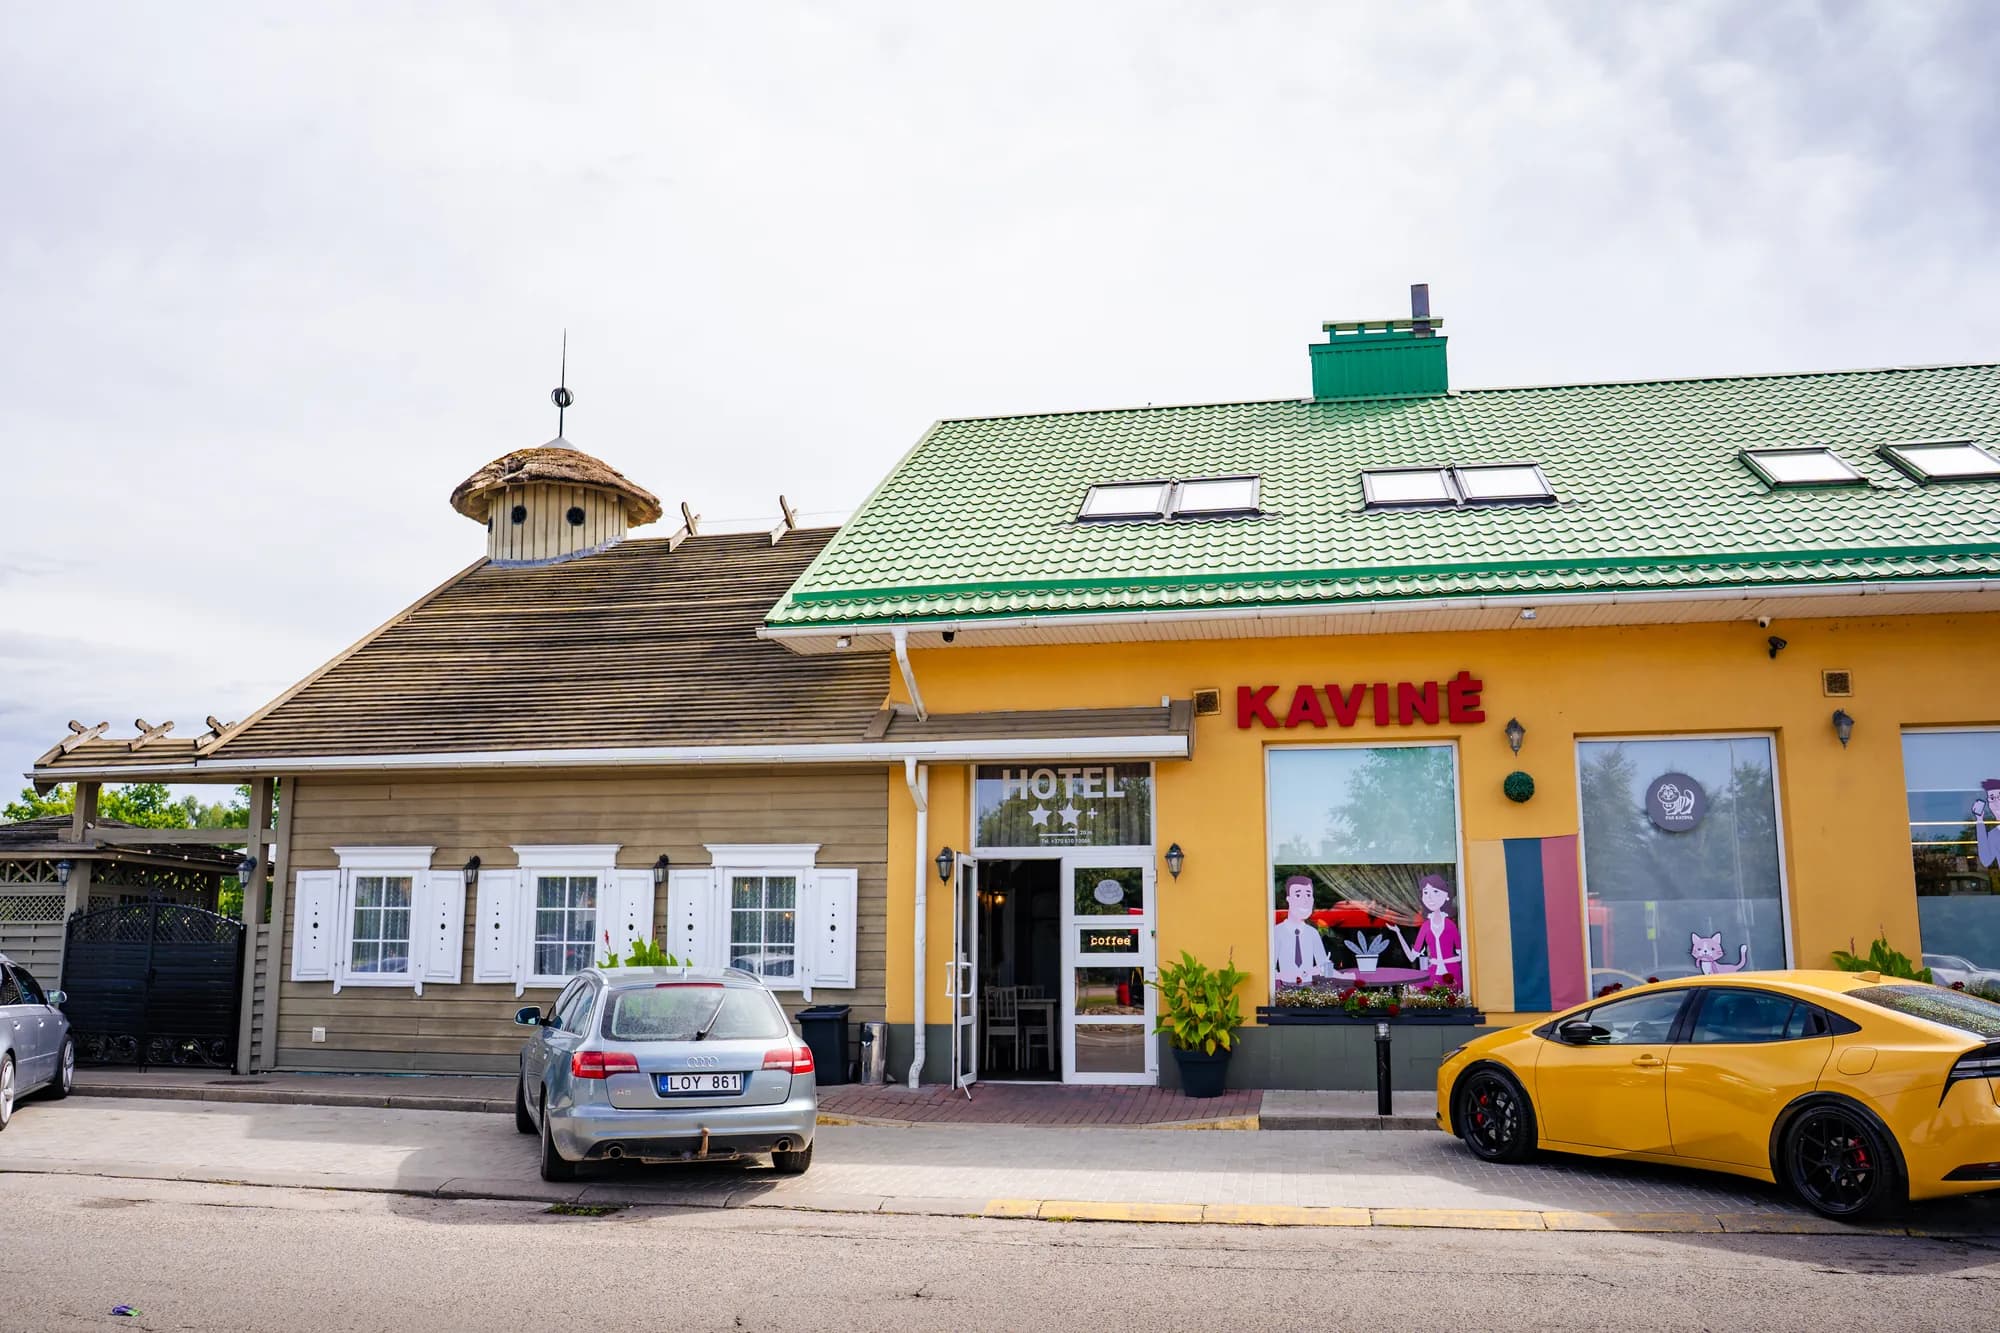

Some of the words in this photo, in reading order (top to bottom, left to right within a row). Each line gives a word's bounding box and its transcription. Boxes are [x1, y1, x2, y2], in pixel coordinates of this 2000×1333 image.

[1237, 671, 1486, 729] KAVINĖ
[1002, 767, 1125, 800] HOTEL
[1090, 935, 1132, 947] coffee
[669, 1076, 701, 1090] LOY
[712, 1075, 737, 1089] 861
